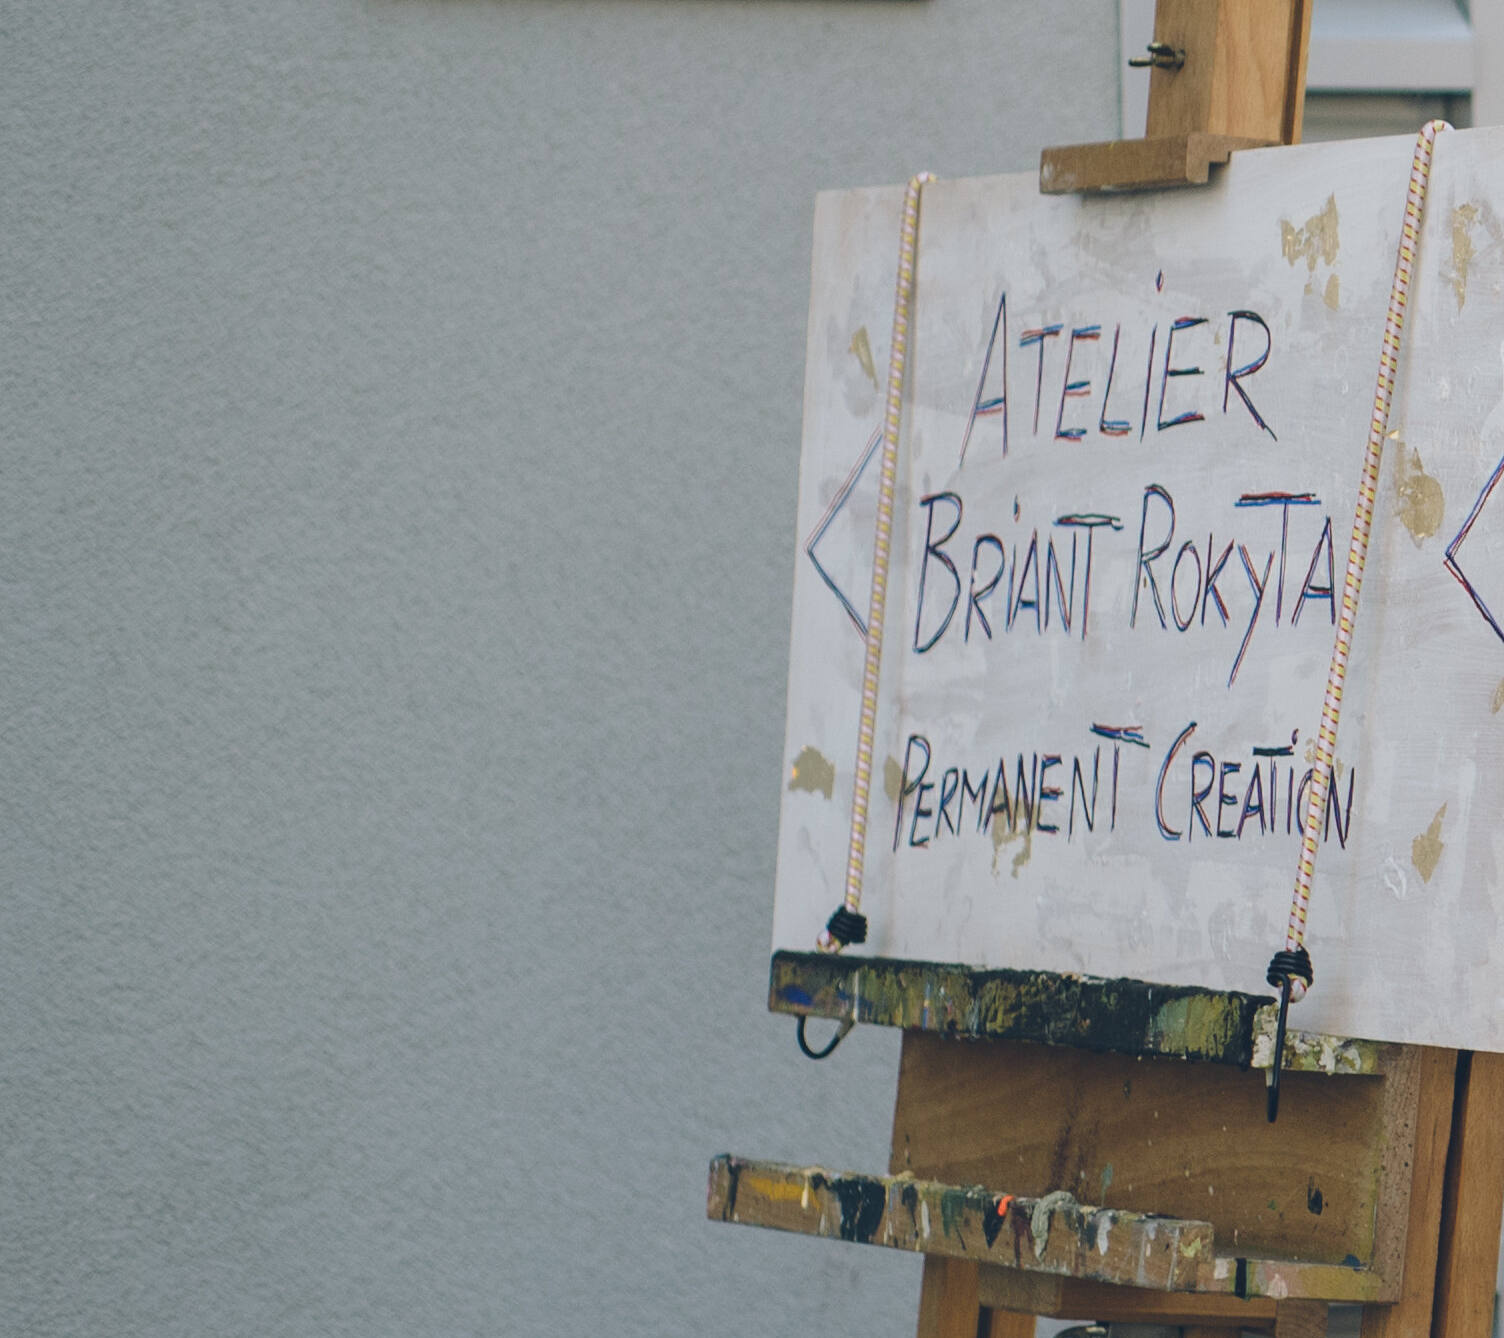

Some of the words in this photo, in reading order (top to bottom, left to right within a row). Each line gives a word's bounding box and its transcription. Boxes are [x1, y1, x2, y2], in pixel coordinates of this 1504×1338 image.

[957, 269, 1278, 469] ATELIER
[912, 489, 1124, 655] BRIANT
[1130, 483, 1338, 688] ROKYTA
[893, 723, 1150, 853] PERMANENT
